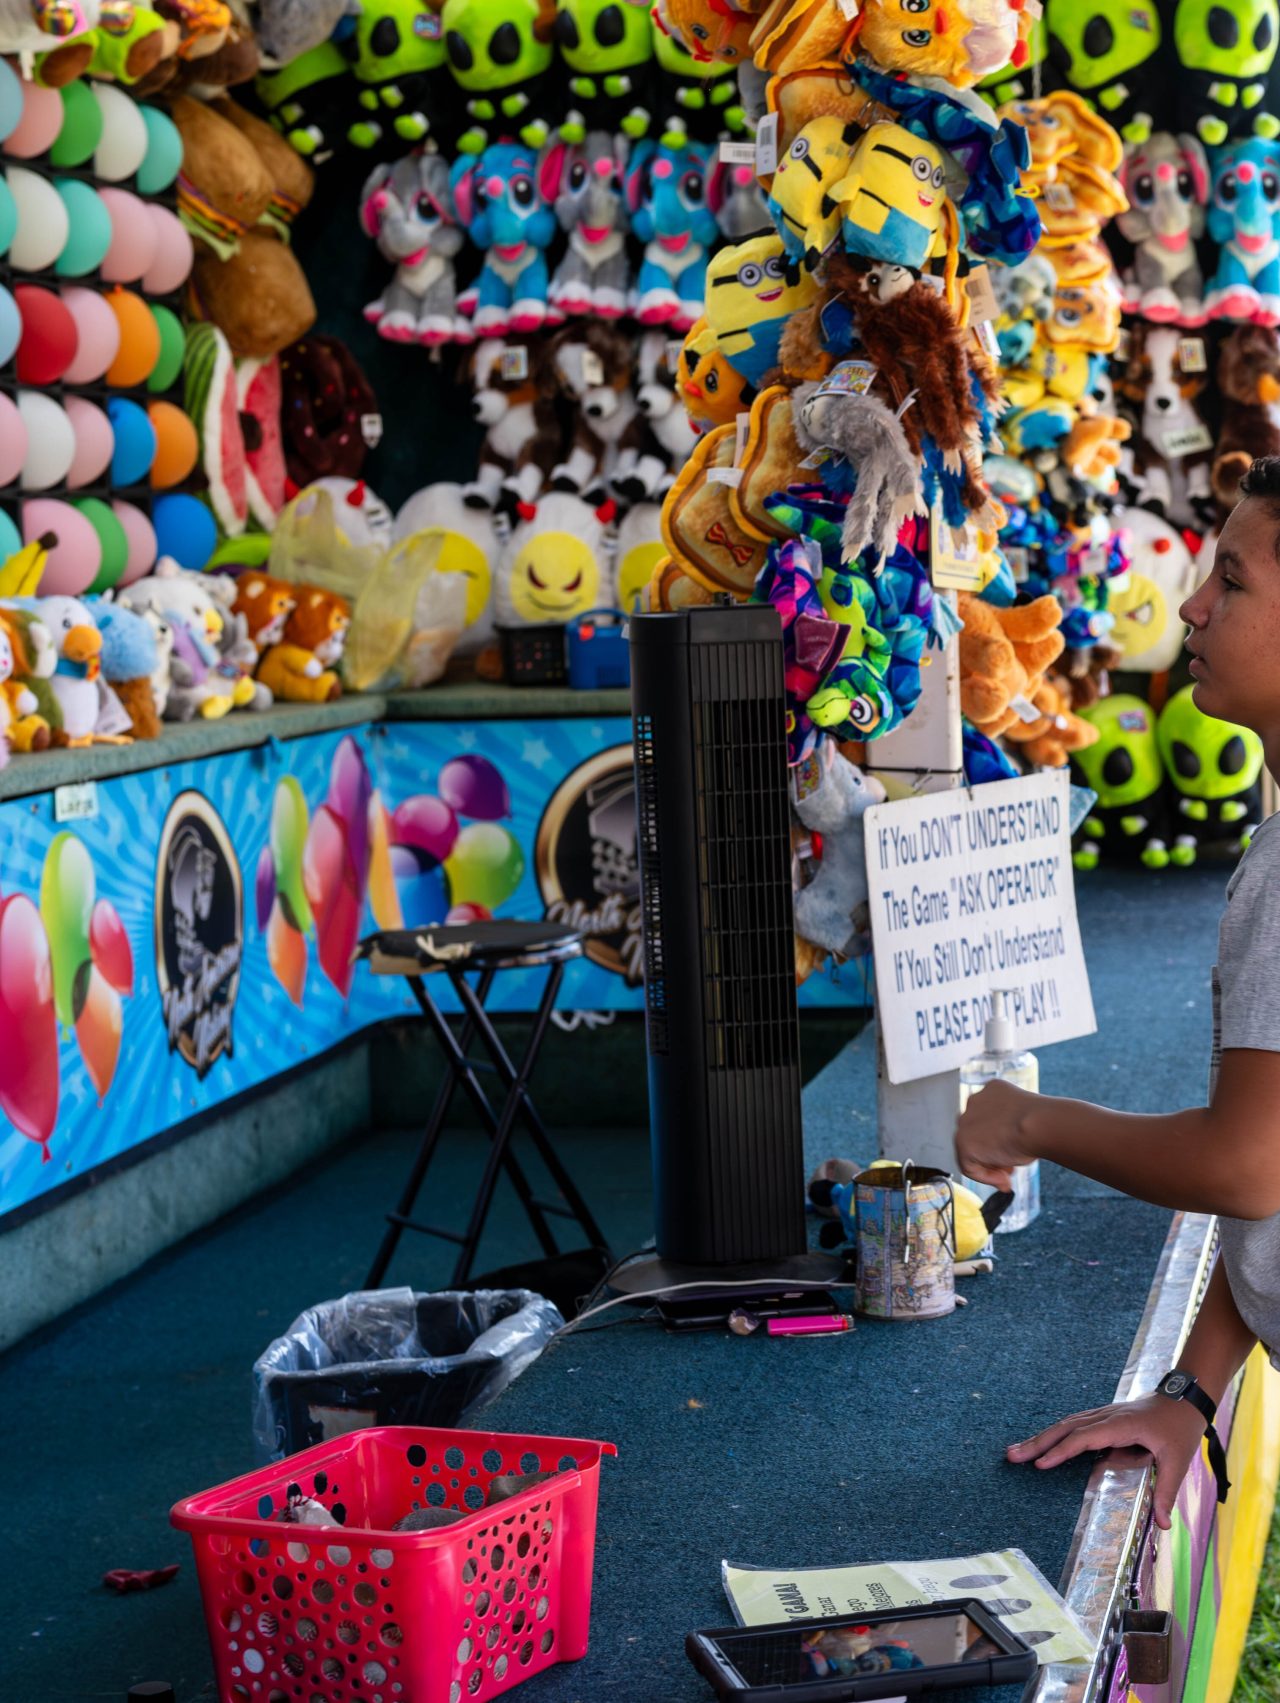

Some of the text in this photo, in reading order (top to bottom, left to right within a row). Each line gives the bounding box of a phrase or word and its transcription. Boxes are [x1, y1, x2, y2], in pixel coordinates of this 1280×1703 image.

[878, 795, 1060, 870] If You DON'T UNDERSTAND
[883, 891, 909, 932] The
[912, 884, 949, 926] Game
[893, 916, 1065, 993] If You Still Don't Understand
[916, 1000, 972, 1051] PLEASE
[1013, 981, 1046, 1027] PLAY
[848, 1599, 867, 1612] ego
